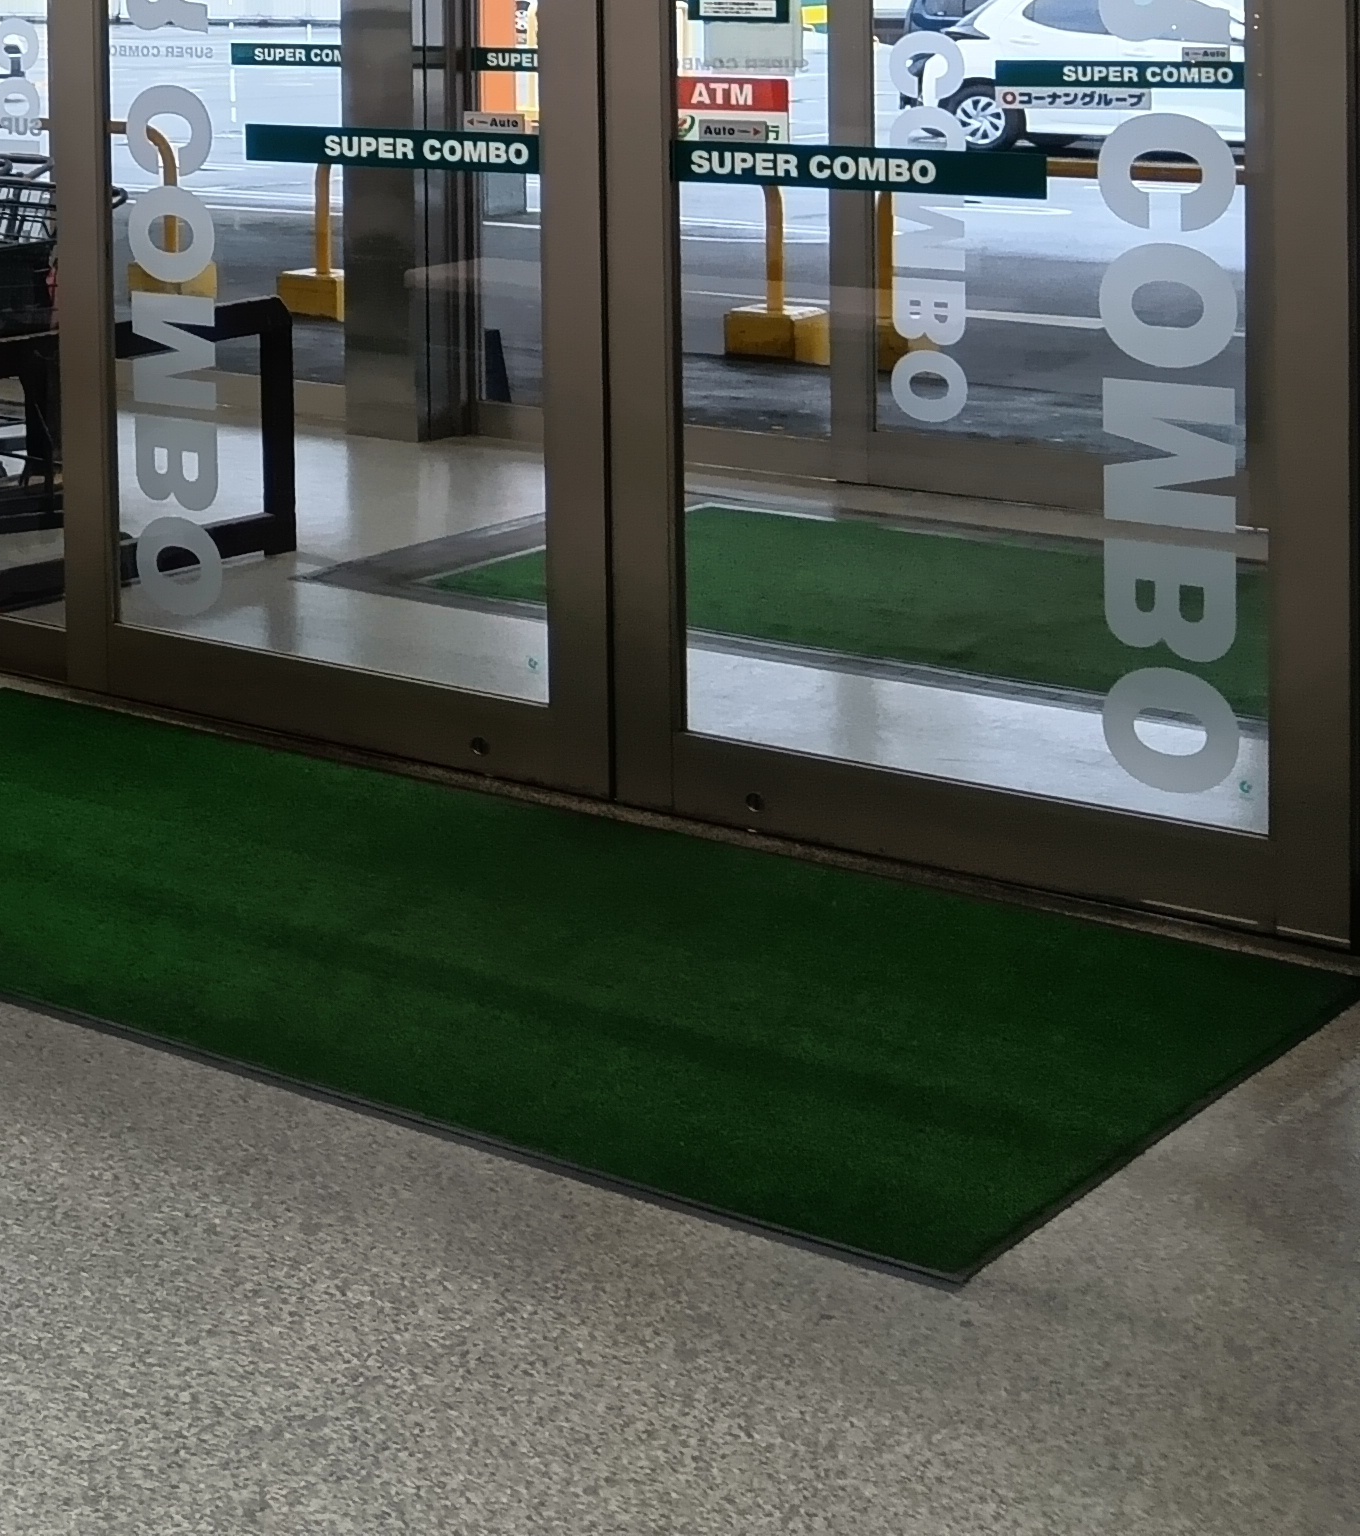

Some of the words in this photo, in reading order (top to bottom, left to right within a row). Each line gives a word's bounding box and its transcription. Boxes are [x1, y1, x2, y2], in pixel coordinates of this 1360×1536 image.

[254, 47, 306, 62] SUPER
[486, 52, 538, 67] SUPE
[1062, 65, 1139, 82] SUPER
[1145, 65, 1234, 84] COMBO
[690, 82, 753, 106] ATM
[1018, 90, 1145, 107] コーナングループ
[489, 117, 519, 128] Auto
[703, 125, 735, 137] Auto
[324, 134, 414, 162] SUPER
[422, 137, 529, 166] COMBO
[691, 149, 800, 182] SUPER
[808, 153, 937, 185] COMBO
